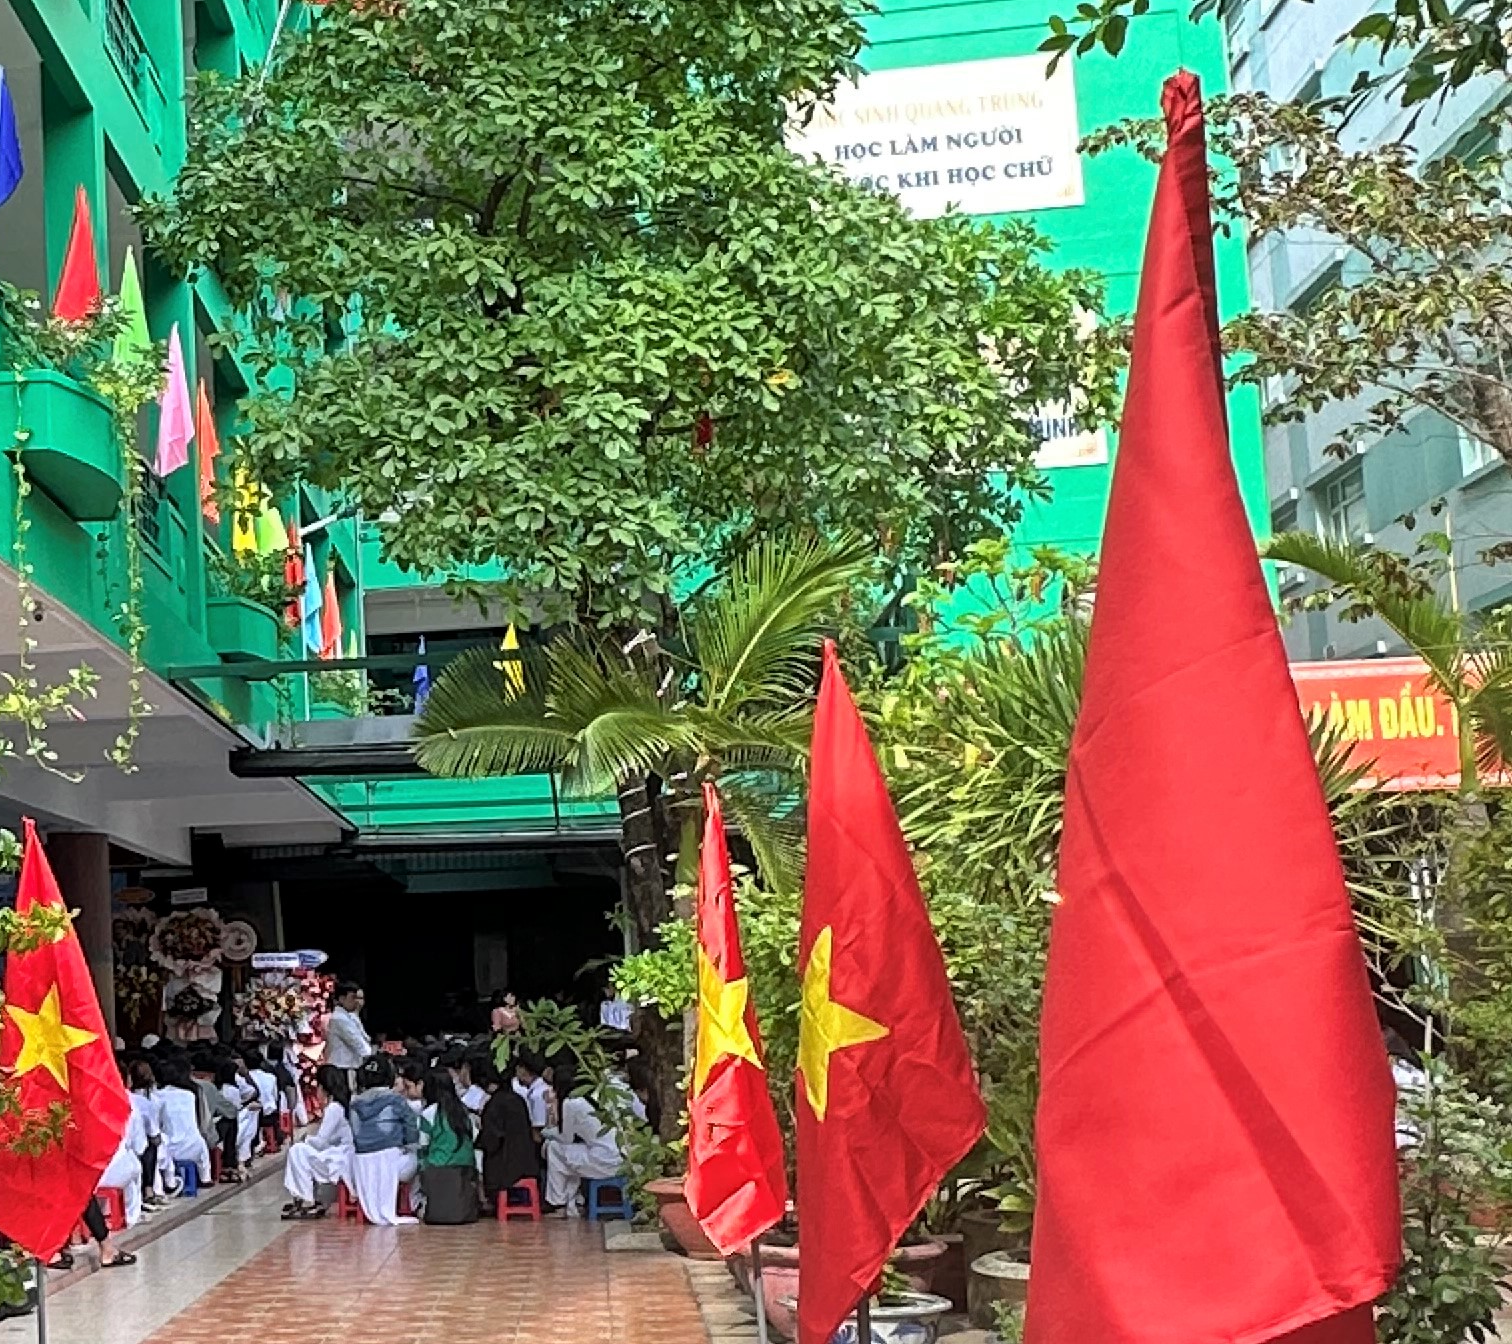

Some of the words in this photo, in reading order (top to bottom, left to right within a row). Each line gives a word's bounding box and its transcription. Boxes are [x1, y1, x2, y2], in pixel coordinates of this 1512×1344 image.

[854, 104, 899, 125] SINH
[904, 97, 972, 126] QUANG
[977, 90, 1044, 113] TRUNG
[834, 140, 883, 164] HỌC
[889, 132, 939, 156] LÀM
[946, 124, 1024, 151] NGƯỜI
[898, 169, 940, 190] KHI
[947, 163, 996, 188] HỌC
[1003, 154, 1054, 180] CHỮ
